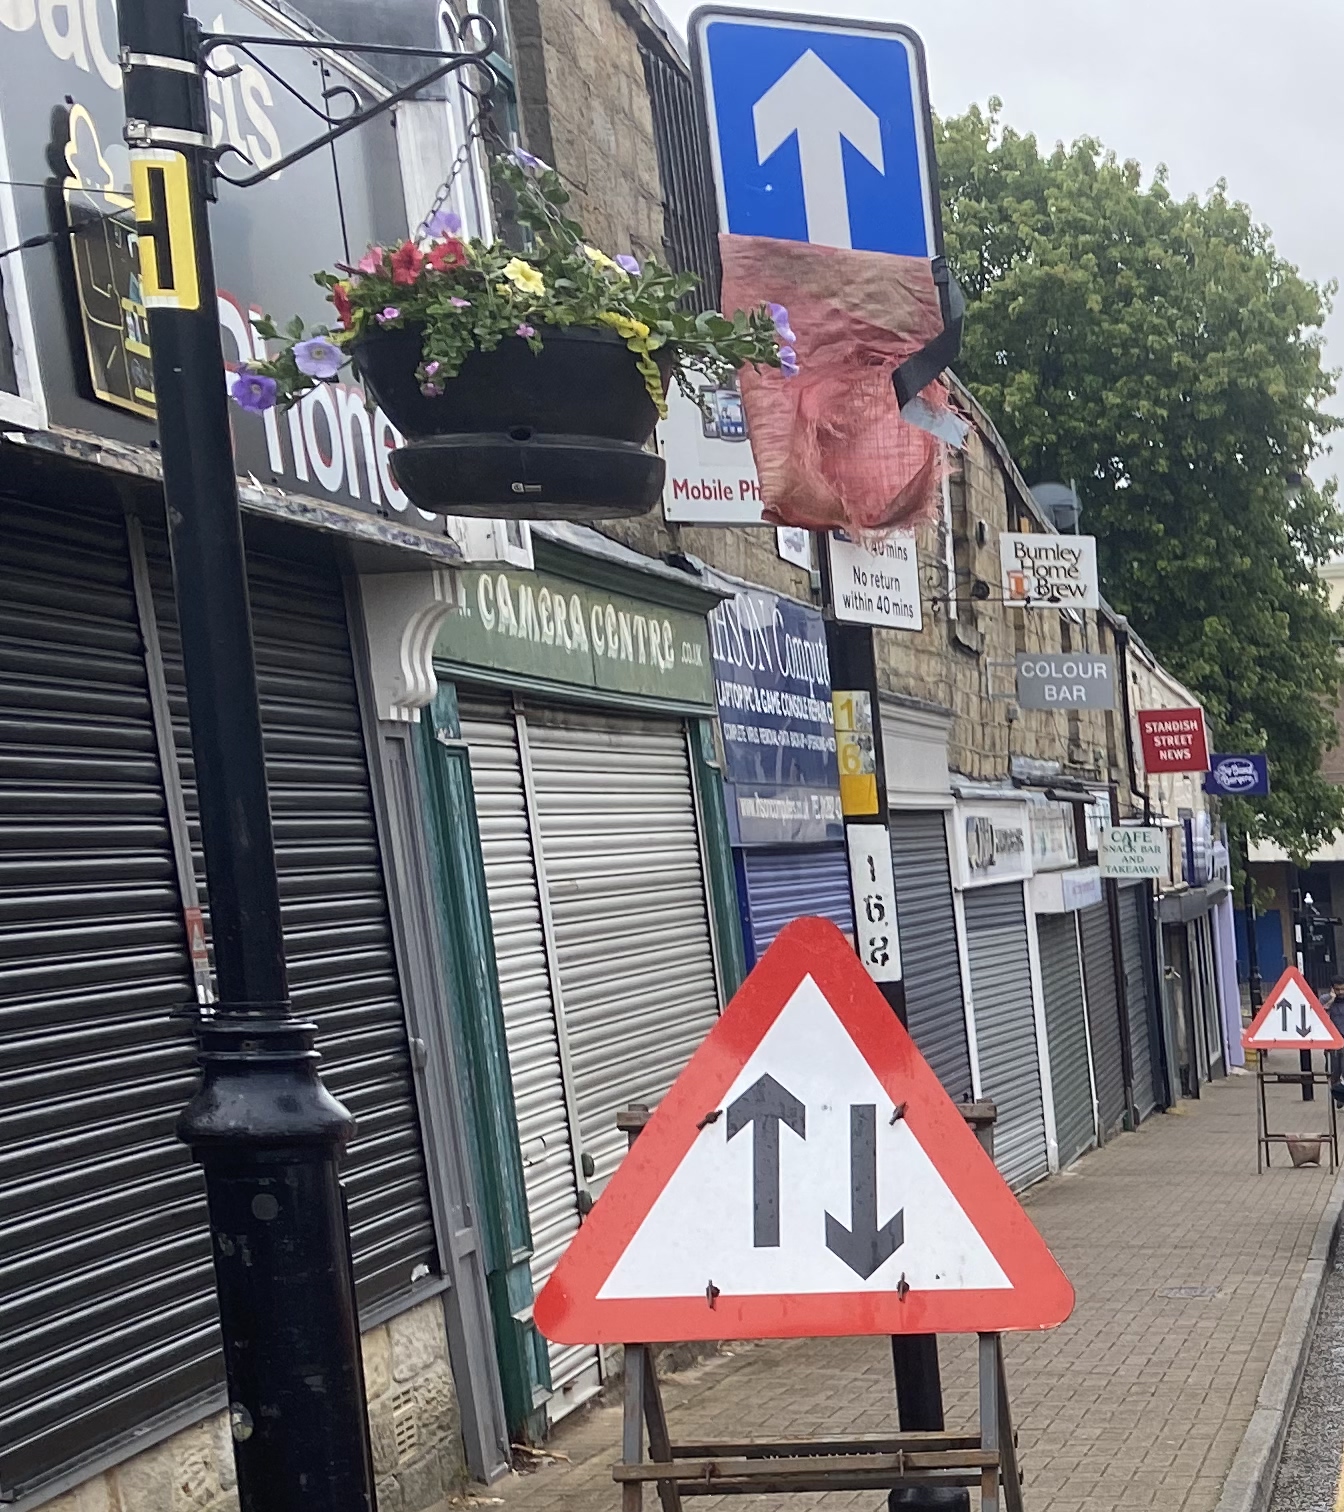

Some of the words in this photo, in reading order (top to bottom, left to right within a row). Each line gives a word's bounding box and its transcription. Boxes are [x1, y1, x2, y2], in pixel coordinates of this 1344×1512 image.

[672, 478, 733, 501] Mobile
[739, 480, 761, 501] Ph
[886, 541, 908, 561] mins
[1013, 540, 1082, 565] Burnley
[1020, 558, 1080, 580] Home
[853, 565, 868, 587] No
[870, 570, 901, 592] return
[1037, 577, 1088, 599] Brew
[842, 590, 874, 612] within
[876, 595, 890, 615] 40
[892, 597, 914, 618] mins
[477, 573, 589, 655] CAMERA
[590, 603, 675, 675] CENTRE
[1021, 661, 1107, 679] COLOUR
[1044, 684, 1086, 702] BAR
[1145, 720, 1199, 734] STANDISH
[1153, 734, 1193, 747] STREET
[1159, 748, 1192, 761] NEWS
[1111, 831, 1151, 842] CAFE
[1102, 844, 1138, 853] SNACK
[1140, 845, 1161, 854] BAR
[1121, 855, 1144, 864] AND
[1105, 864, 1161, 874] TAKEAWAY
